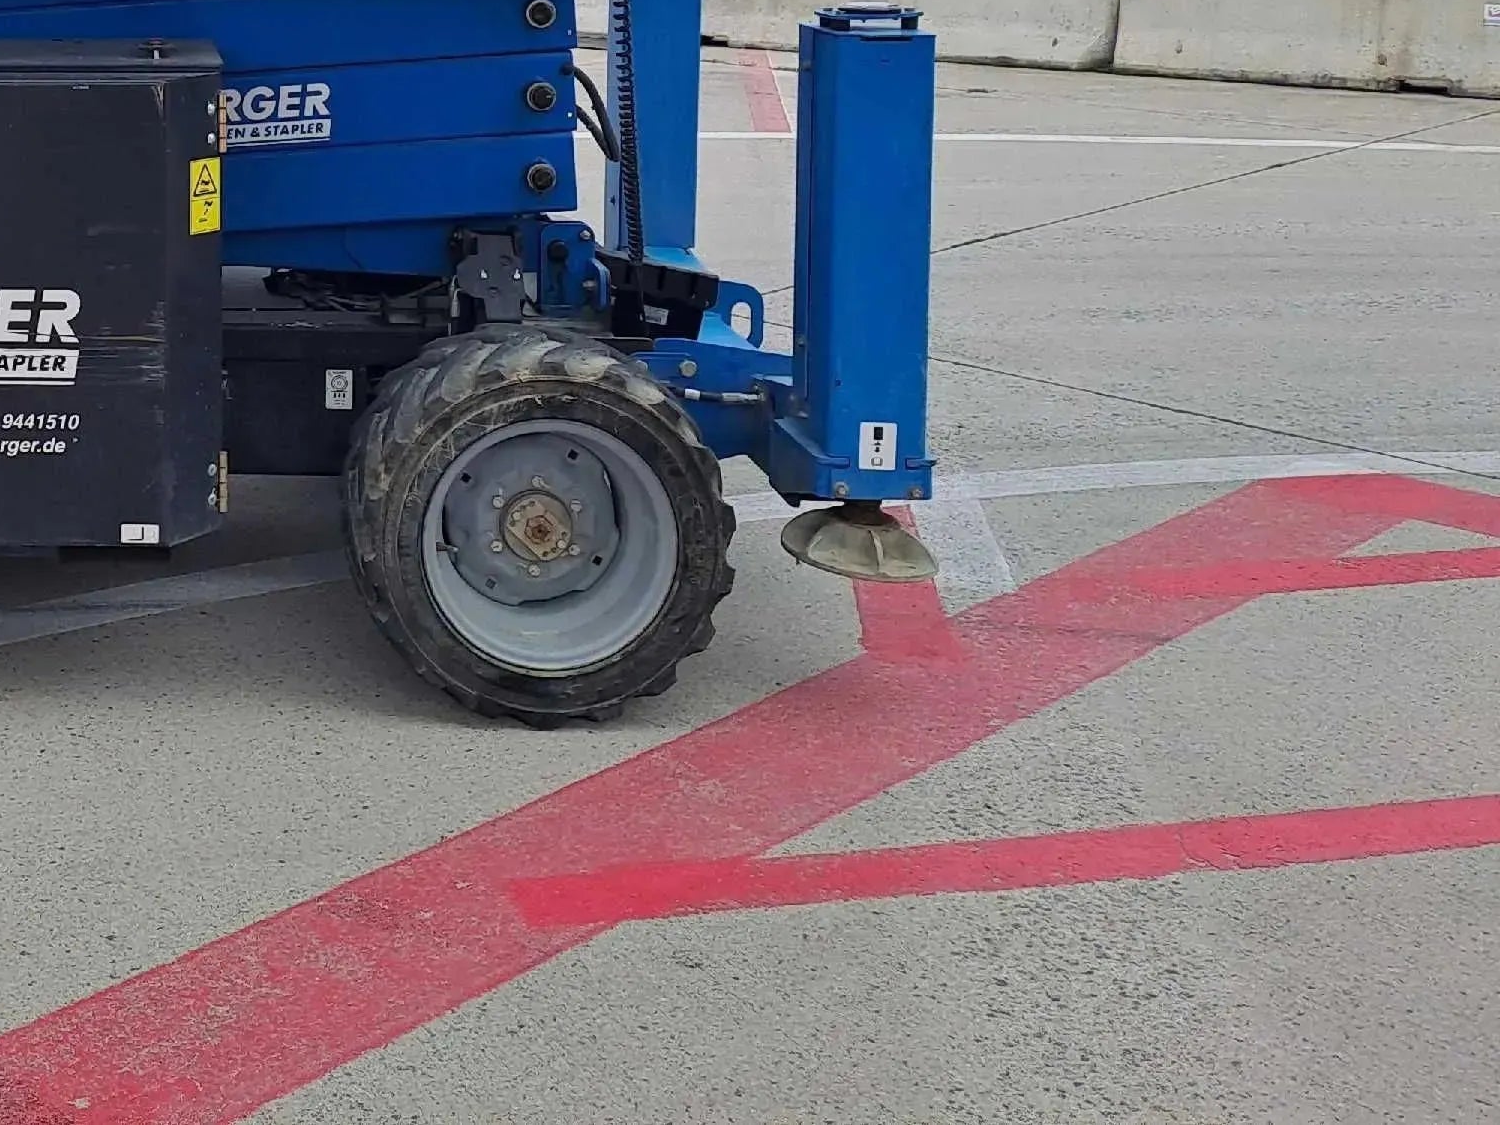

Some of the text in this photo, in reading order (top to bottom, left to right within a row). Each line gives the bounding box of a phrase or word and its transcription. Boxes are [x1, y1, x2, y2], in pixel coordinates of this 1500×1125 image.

[250, 126, 261, 138] &
[264, 122, 324, 137] STAPLER
[2, 414, 80, 430] 9441510
